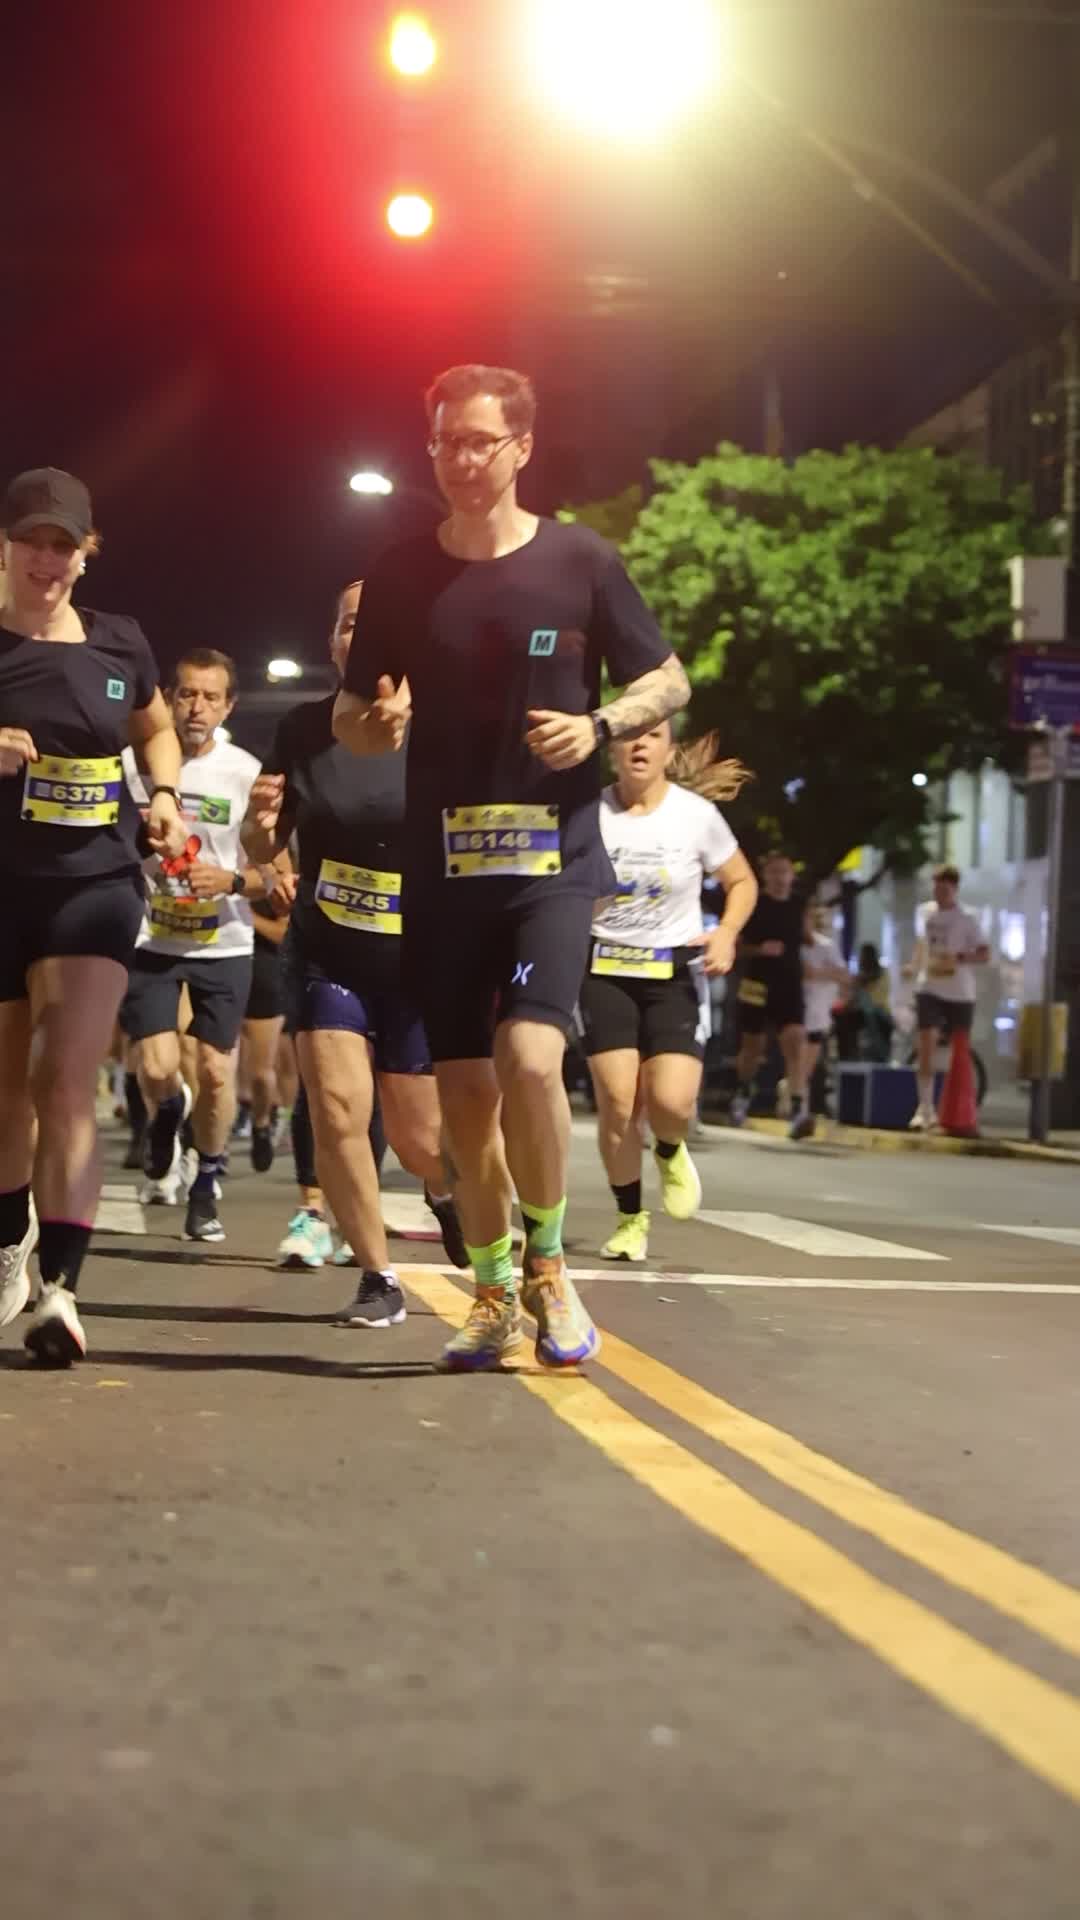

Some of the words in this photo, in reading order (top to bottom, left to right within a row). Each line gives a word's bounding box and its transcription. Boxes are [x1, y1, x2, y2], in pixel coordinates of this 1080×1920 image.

[53, 784, 107, 802] 6379
[469, 831, 531, 849] 6146
[336, 889, 390, 911] 5745
